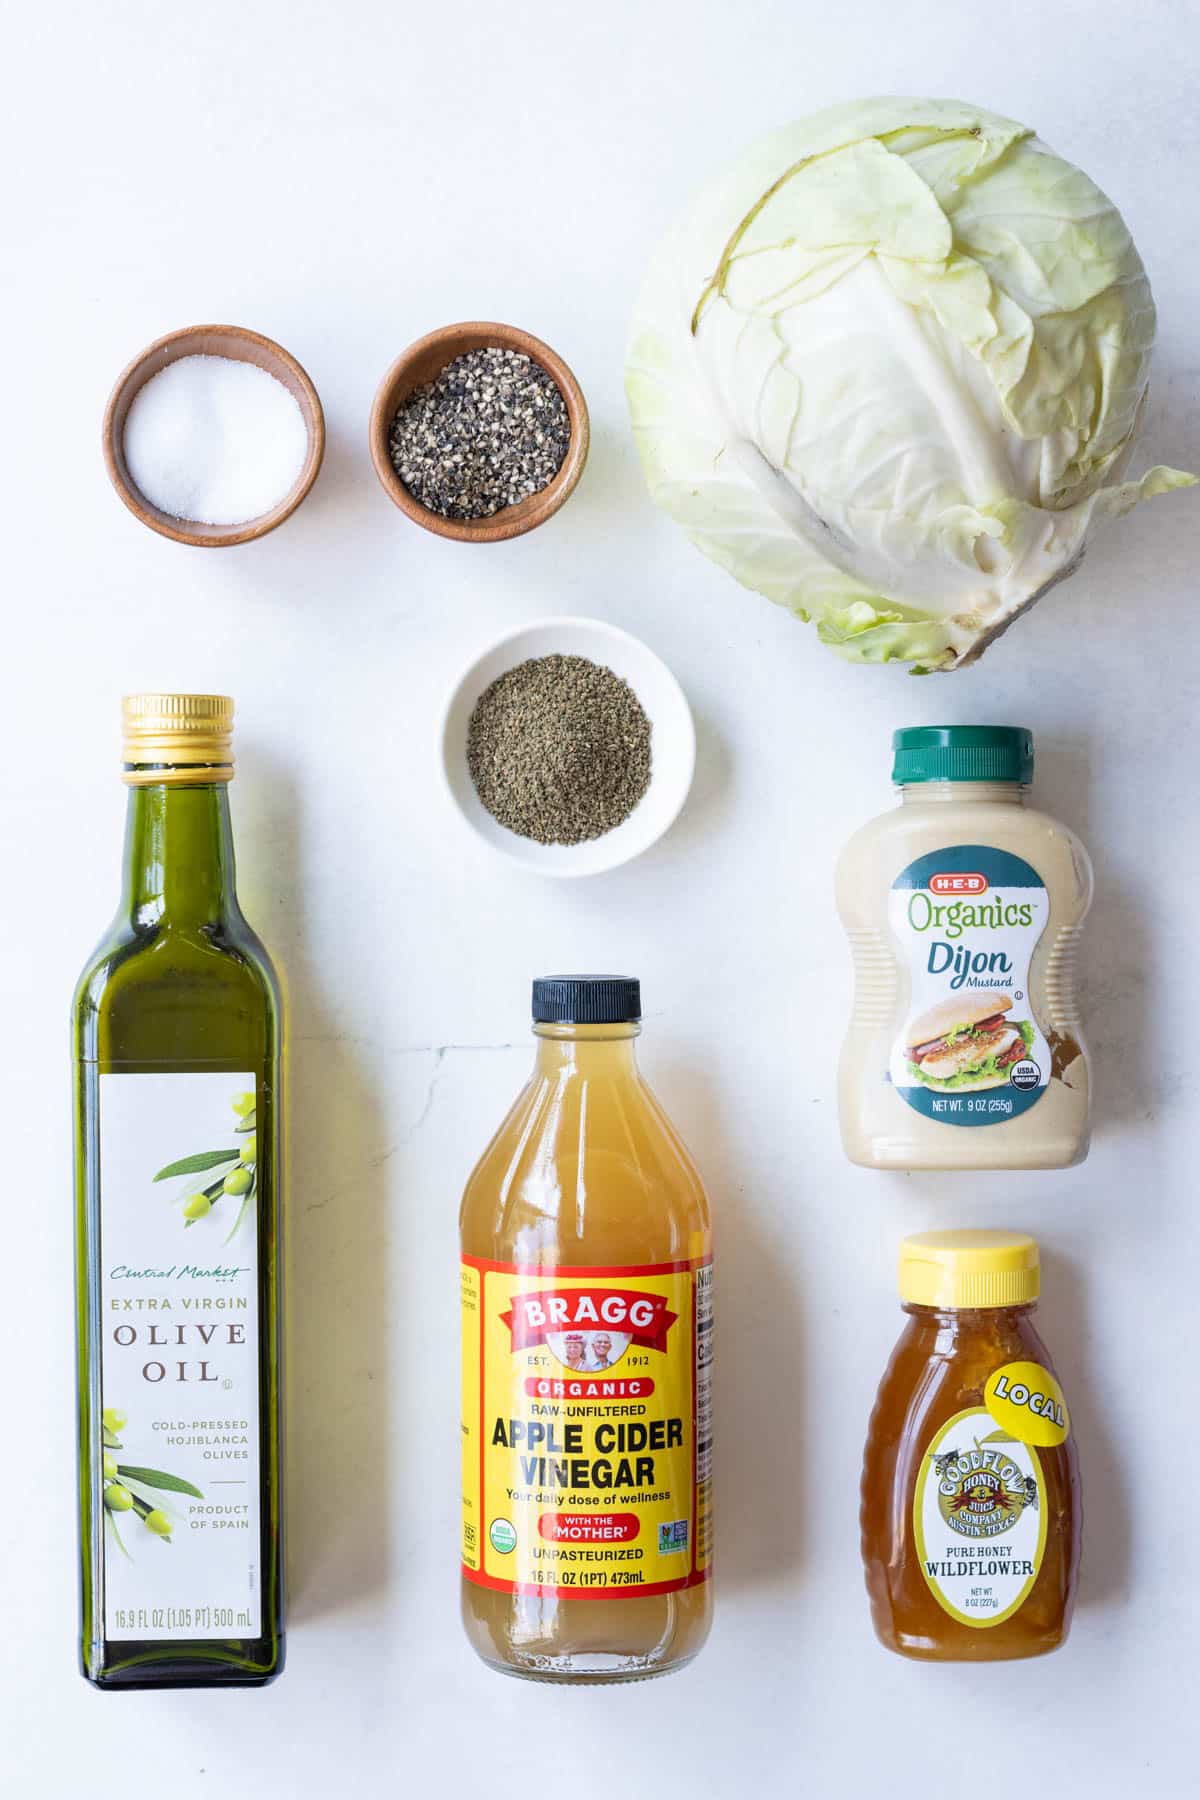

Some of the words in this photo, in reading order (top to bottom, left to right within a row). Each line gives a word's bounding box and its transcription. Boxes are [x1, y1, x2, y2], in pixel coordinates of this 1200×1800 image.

[908, 893, 1032, 938] Organics
[928, 942, 1013, 990] Dijon
[966, 976, 1013, 988] Mustard
[932, 1100, 947, 1112] NET
[967, 1100, 974, 1112] 9
[975, 1100, 986, 1112] OZ
[988, 1099, 1013, 1114] (255g)
[110, 1266, 176, 1279] Central
[177, 1265, 250, 1279] Market
[111, 1298, 172, 1310] EXTRA
[182, 1298, 248, 1310] VIRGIN
[524, 1296, 655, 1328] BRAGG
[113, 1324, 246, 1346] OLIVE
[627, 1356, 649, 1367] 1912
[142, 1361, 219, 1383] OIL
[537, 1381, 641, 1396] ORGANIC
[994, 1375, 1066, 1428] LOCAL
[152, 1421, 248, 1431] COLD-PRESSED
[167, 1435, 248, 1446] HOJIBLANCA
[492, 1418, 583, 1453] APPLE
[595, 1418, 683, 1453] CIDER
[203, 1450, 248, 1460] OLIVES
[519, 1456, 655, 1489] VINEGAR
[940, 1450, 1026, 1497] GOODFLOW
[963, 1474, 1000, 1493] HONEY
[535, 1493, 565, 1506] daily
[569, 1495, 600, 1505] dose
[603, 1495, 616, 1505] of
[619, 1490, 671, 1504] wellness
[189, 1505, 249, 1515] PRODUCT
[968, 1500, 995, 1512] JUICE
[565, 1517, 591, 1525] WITH
[593, 1517, 613, 1525] THE
[960, 1508, 1002, 1525] COMPANY
[190, 1520, 208, 1529] OF
[212, 1520, 249, 1529] SPAIN
[533, 1548, 644, 1561] UNPASTEURIZED
[946, 1547, 975, 1558] PURE
[978, 1546, 1012, 1557] HONEY
[926, 1561, 1034, 1577] WILDFLOWER
[531, 1571, 543, 1583] 16
[562, 1572, 576, 1584] OZ
[579, 1572, 607, 1586] (1PT)
[610, 1571, 645, 1584] 473mL
[971, 1588, 982, 1596] NET
[115, 1610, 135, 1628] 16.9
[139, 1610, 148, 1628] FL
[152, 1610, 164, 1628] OZ
[214, 1609, 233, 1627] 500
[237, 1608, 253, 1627] mL
